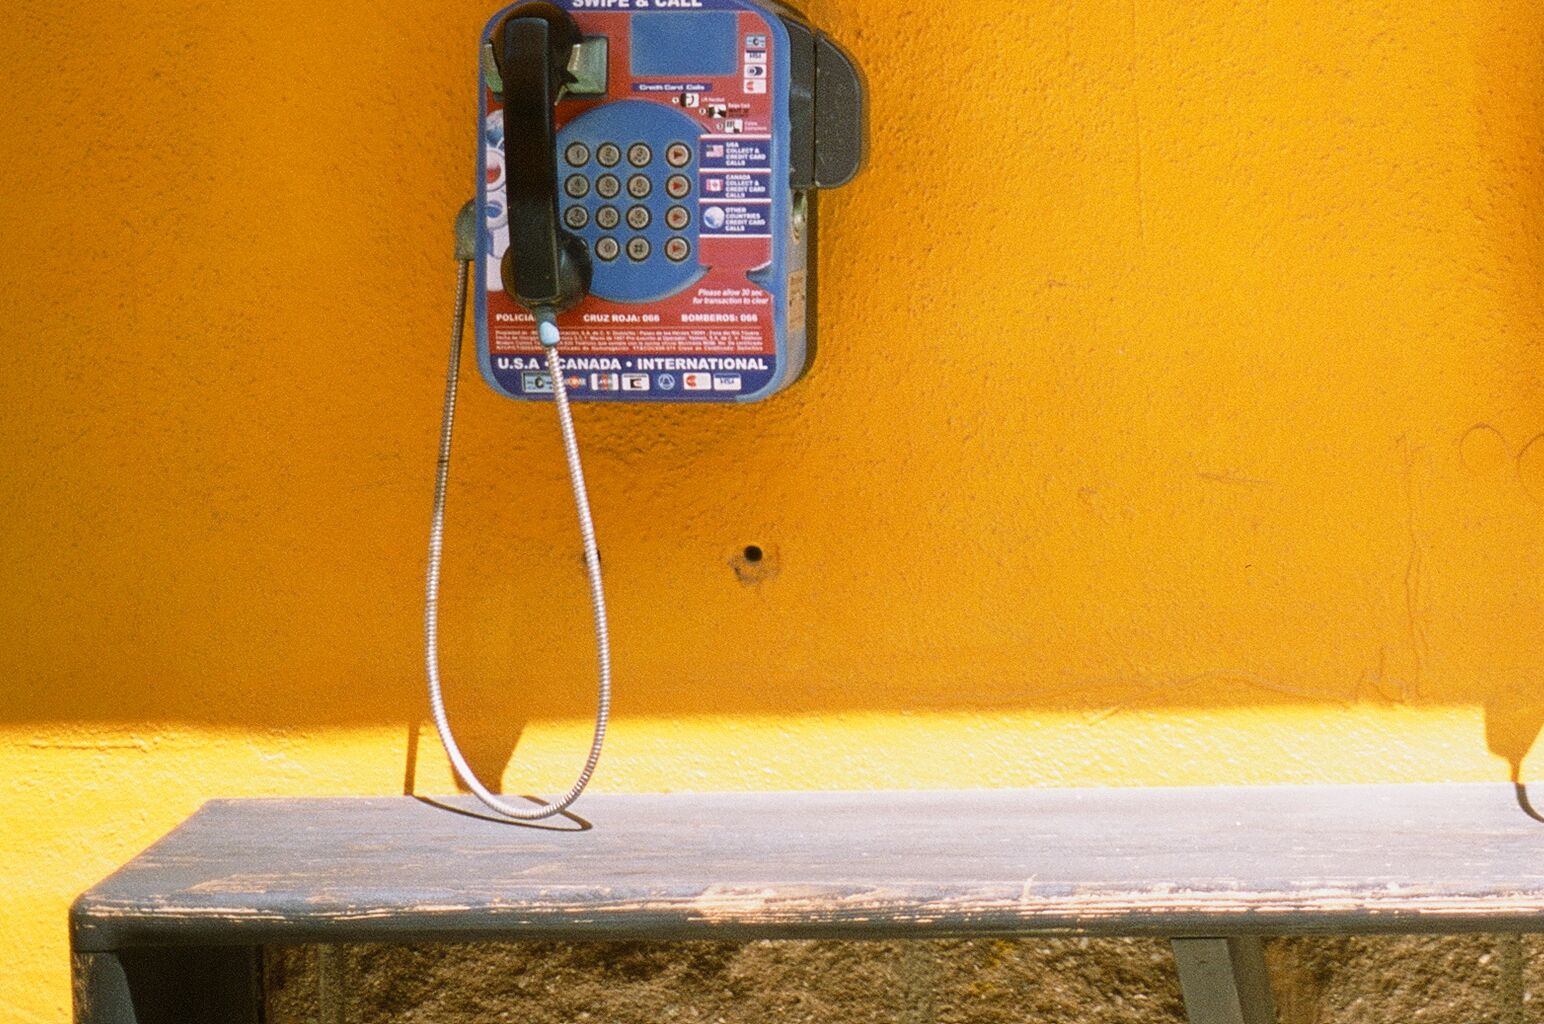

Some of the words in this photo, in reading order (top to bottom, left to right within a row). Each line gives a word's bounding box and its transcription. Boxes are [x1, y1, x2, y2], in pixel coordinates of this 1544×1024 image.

[583, 314, 610, 322] CRUZ
[612, 314, 640, 322] ROJA:
[681, 314, 738, 322] BOMBEROS:
[497, 358, 540, 370] U.S.A
[637, 358, 768, 370] INTERNATIONAL
